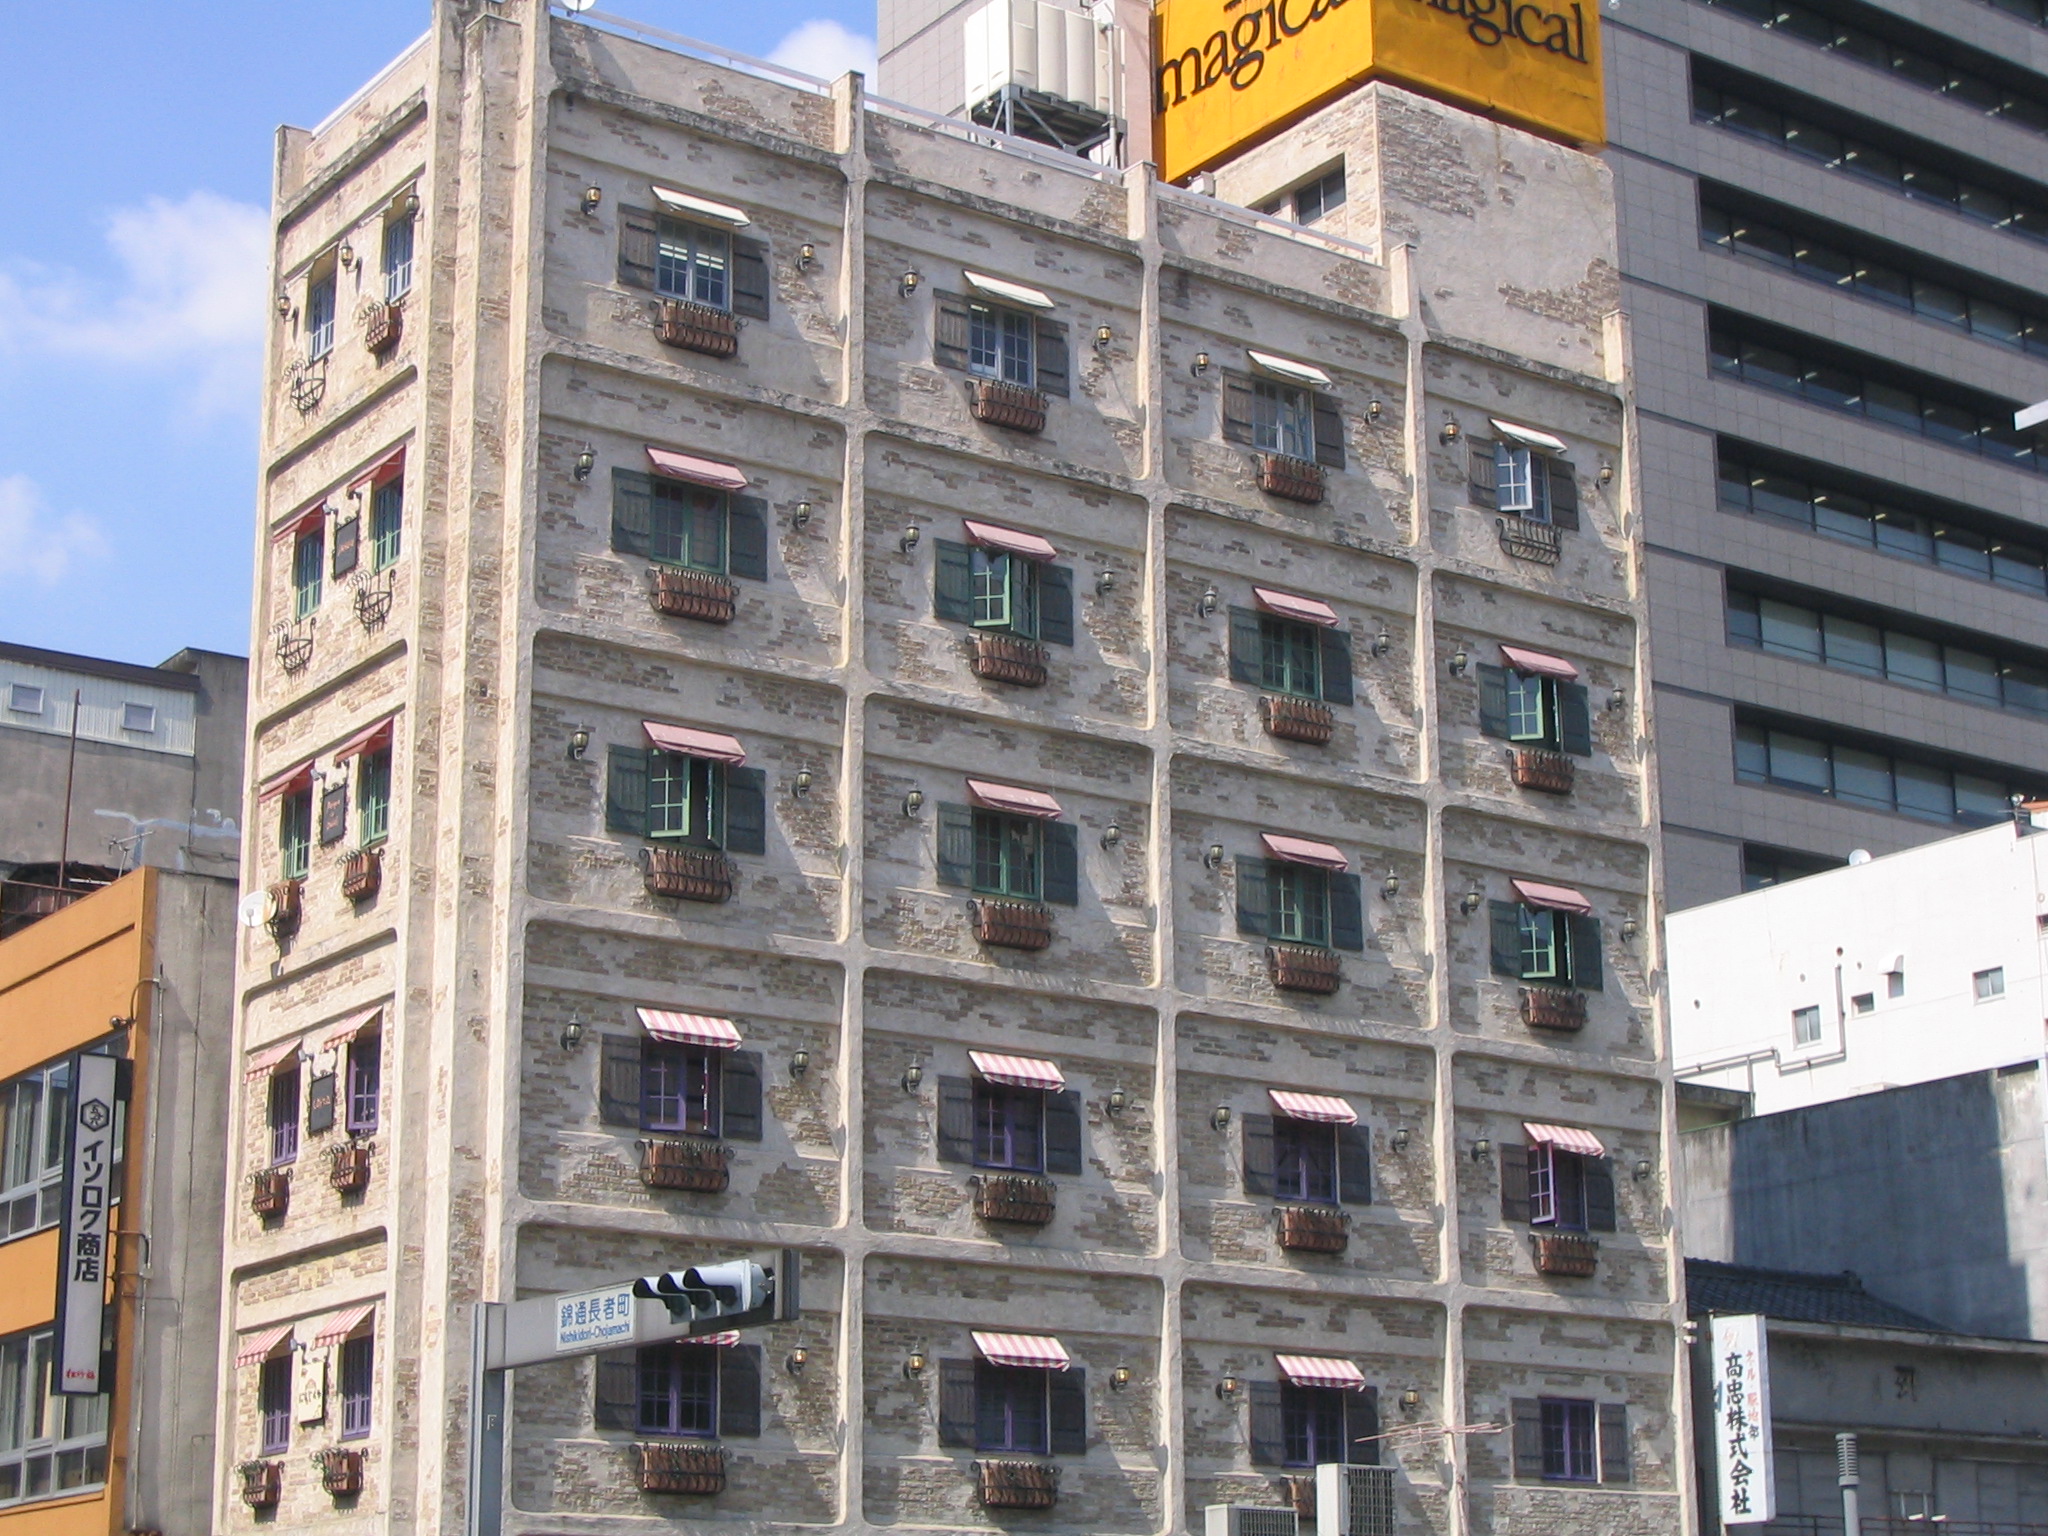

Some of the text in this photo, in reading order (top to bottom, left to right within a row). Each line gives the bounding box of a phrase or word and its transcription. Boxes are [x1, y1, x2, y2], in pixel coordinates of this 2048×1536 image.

[73, 1140, 104, 1282] イソロク商店
[561, 1293, 630, 1328] 錦通長者町
